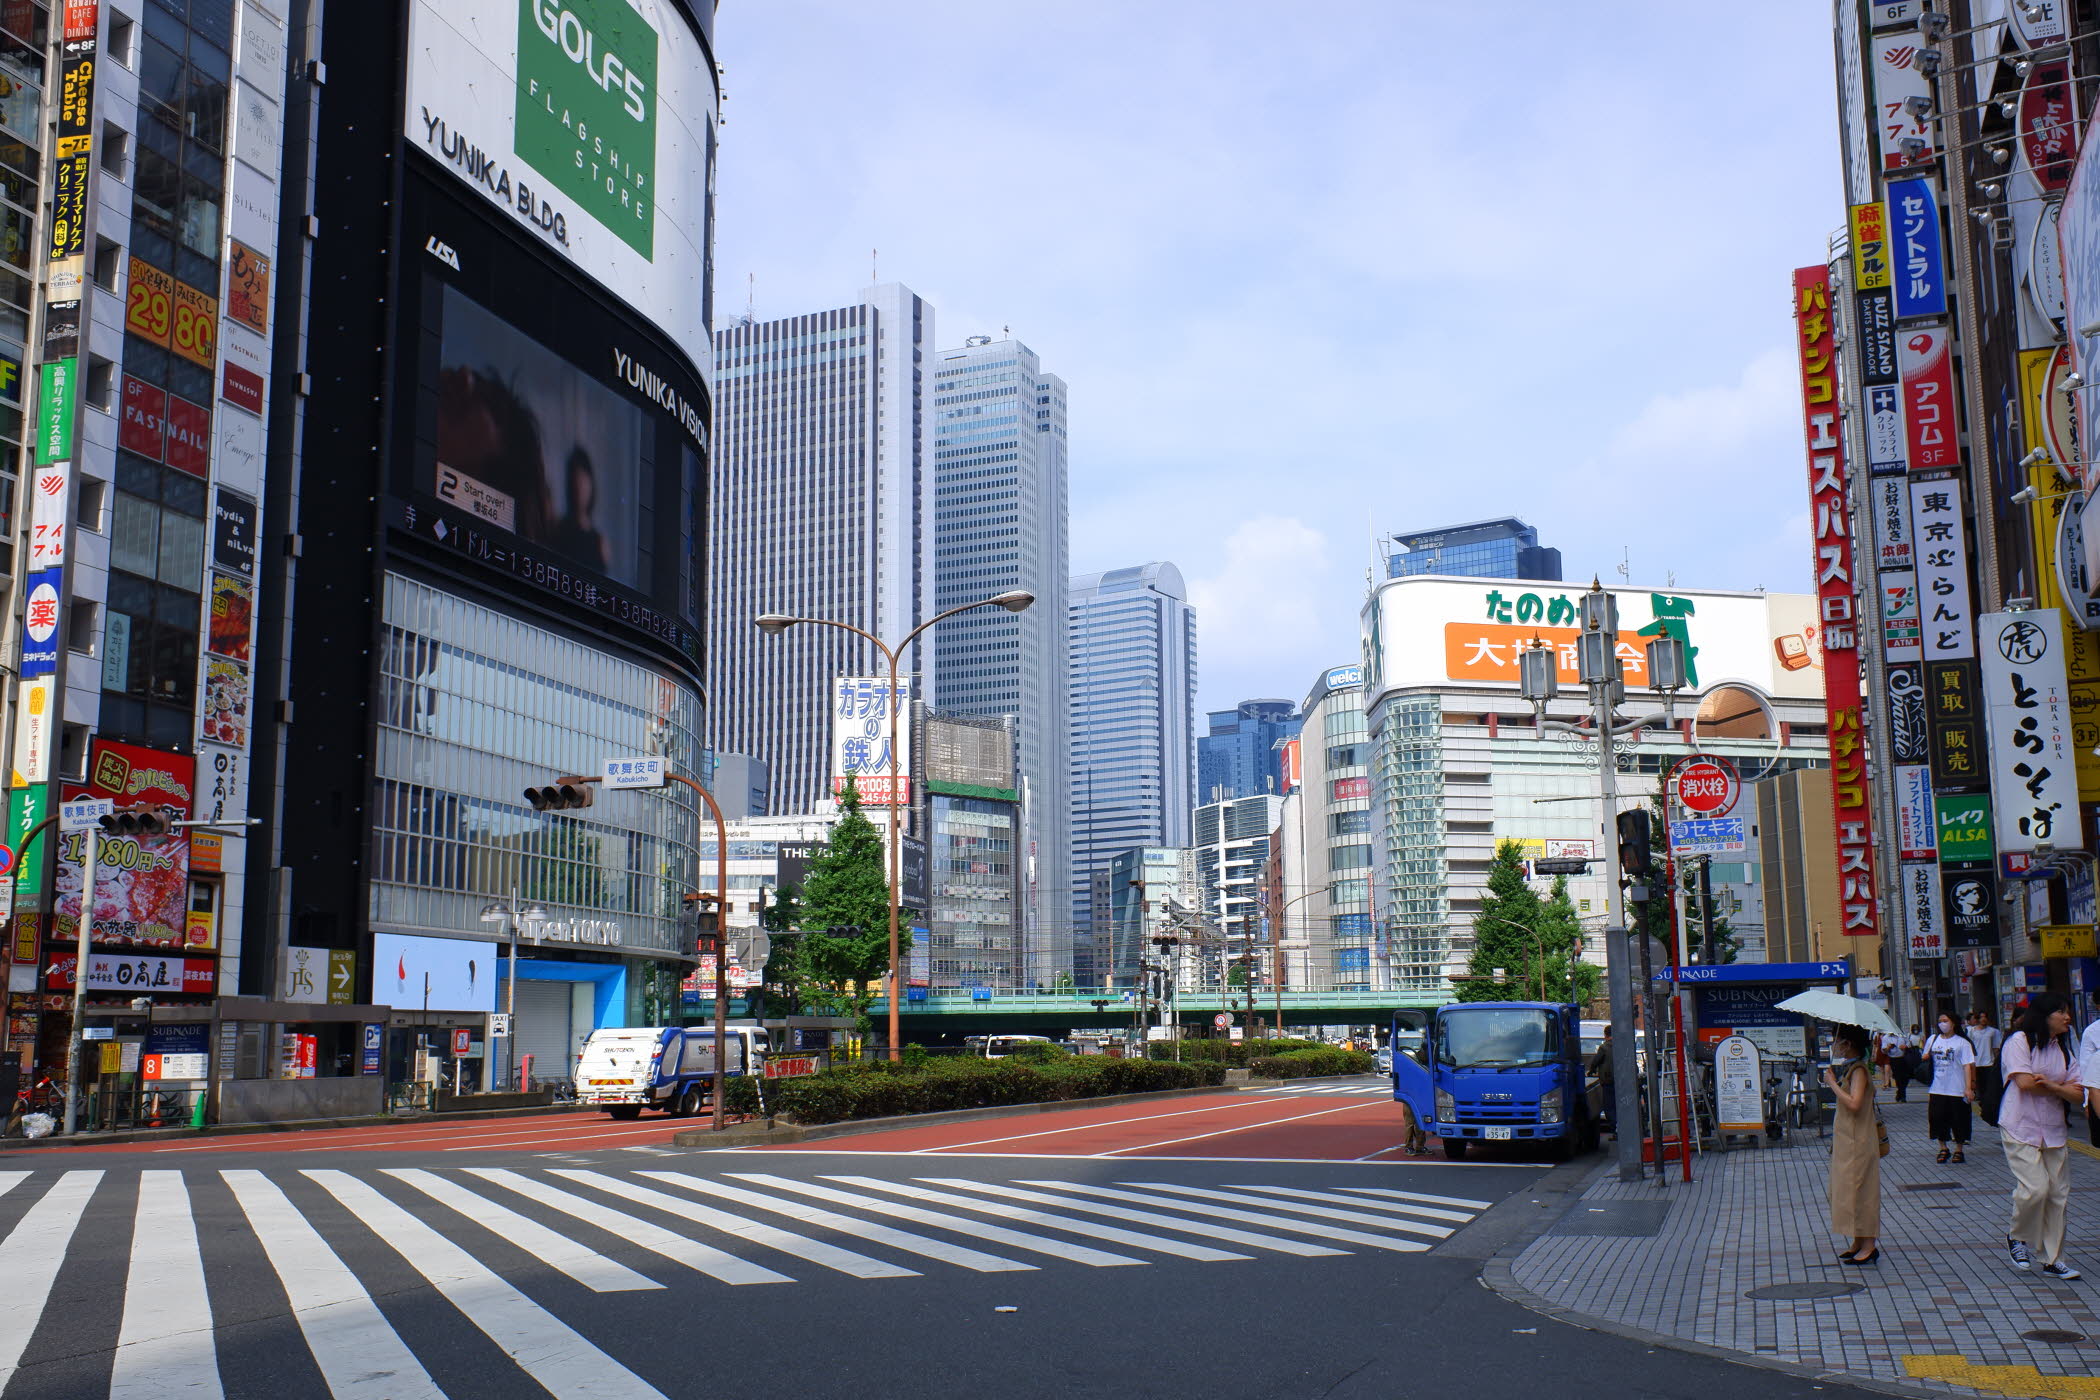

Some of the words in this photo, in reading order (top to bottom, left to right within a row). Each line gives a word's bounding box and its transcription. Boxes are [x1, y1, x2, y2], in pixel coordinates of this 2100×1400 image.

[72, 8, 92, 19] CAFE
[78, 19, 84, 27] &
[1887, 6, 1907, 19] 6F
[67, 26, 96, 38] DINING
[81, 40, 96, 51] 8F
[63, 69, 78, 122] Table
[76, 61, 93, 127] Cheese
[72, 138, 89, 151] 7F
[530, 78, 645, 190] FLAGSHIP
[421, 105, 514, 204] YUNIKA
[516, 180, 571, 248] BLDG.
[575, 149, 644, 220] STORE
[56, 163, 71, 219] クリニック
[69, 171, 87, 251] プライマリケア
[56, 222, 66, 244] 内科
[51, 248, 64, 258] 6F
[1901, 196, 1931, 299] セントラル
[255, 259, 268, 274] 7F
[1865, 275, 1883, 287] 6F
[66, 301, 77, 309] 5F
[1862, 299, 1871, 326] DARTS
[1873, 296, 1887, 332] BUZZ
[231, 343, 260, 361] FASTNAIL
[1801, 282, 1833, 404] パチンコ
[1865, 332, 1877, 377] KARAOKE
[1875, 334, 1892, 375] STAND
[128, 381, 143, 397] 6F
[614, 346, 677, 417] YUNIKA
[678, 396, 708, 454] VISION
[1915, 382, 1944, 446] アコム
[126, 405, 204, 451] FASTNAIL
[1877, 416, 1887, 454] クリニック
[1887, 415, 1897, 460] メンズライフ
[1922, 449, 1944, 464] 3F
[440, 471, 458, 500] 2
[464, 481, 484, 500] Start
[216, 505, 245, 525] Rydia
[404, 504, 416, 530] 寺
[1884, 482, 1902, 541] お好み焼き
[232, 526, 240, 536] &
[227, 538, 255, 556] niLva
[1882, 544, 1910, 557] 本陣
[240, 562, 252, 572] 4F
[1884, 557, 1909, 565] HONJIN
[1922, 492, 1960, 650] 東京ぶらんど
[29, 599, 57, 628] 薬
[1890, 620, 1913, 628] たばこ
[1893, 638, 1914, 647] ATM
[2003, 623, 2041, 660] 虎
[1941, 670, 1964, 712] 買取
[1889, 669, 1924, 758] Sparkle
[2048, 687, 2058, 721] TORA
[863, 715, 881, 742] の
[1911, 701, 1928, 758] スパークル
[2075, 728, 2097, 743] 3F
[27, 718, 39, 777] 生フォー専門店
[1945, 729, 1971, 772] 販売
[2052, 725, 2063, 760] SOBA
[103, 756, 124, 776] 炭火
[842, 737, 903, 775] 鉄人
[1833, 705, 1865, 808] パチンコ
[2010, 672, 2063, 839] とらそば
[607, 760, 658, 776] 歌舞伎町
[616, 774, 649, 785] Kabukicho
[1697, 768, 1719, 776] HYDRANT
[212, 752, 229, 820] 日高屋
[1682, 777, 1725, 798] 消火栓
[21, 794, 35, 830] レイク
[64, 803, 108, 818] 歌舞伎町
[1909, 781, 1924, 848] ファイトフィット
[1941, 809, 1984, 825] レイク
[1685, 834, 1738, 845] 03-3352-7325
[1690, 818, 1743, 837] セキネ
[1942, 828, 1987, 843] ALSA
[1692, 843, 1724, 852] アルタ裏
[1726, 841, 1743, 850] 買取
[1840, 820, 1874, 930] エスパス
[1914, 869, 1931, 932] お好み焼き
[570, 917, 623, 946] TOKYO
[1953, 915, 1990, 924] DAVIDE
[1911, 935, 1940, 948] 本陣
[1914, 949, 1940, 957] HONJIN
[116, 960, 170, 987] 日高屋
[1821, 964, 1829, 975] P
[1708, 989, 1790, 1002] SUBNADE
[153, 1026, 201, 1037] SUBNADE
[146, 1059, 156, 1074] 8
[1490, 1131, 1510, 1139] 35-47
